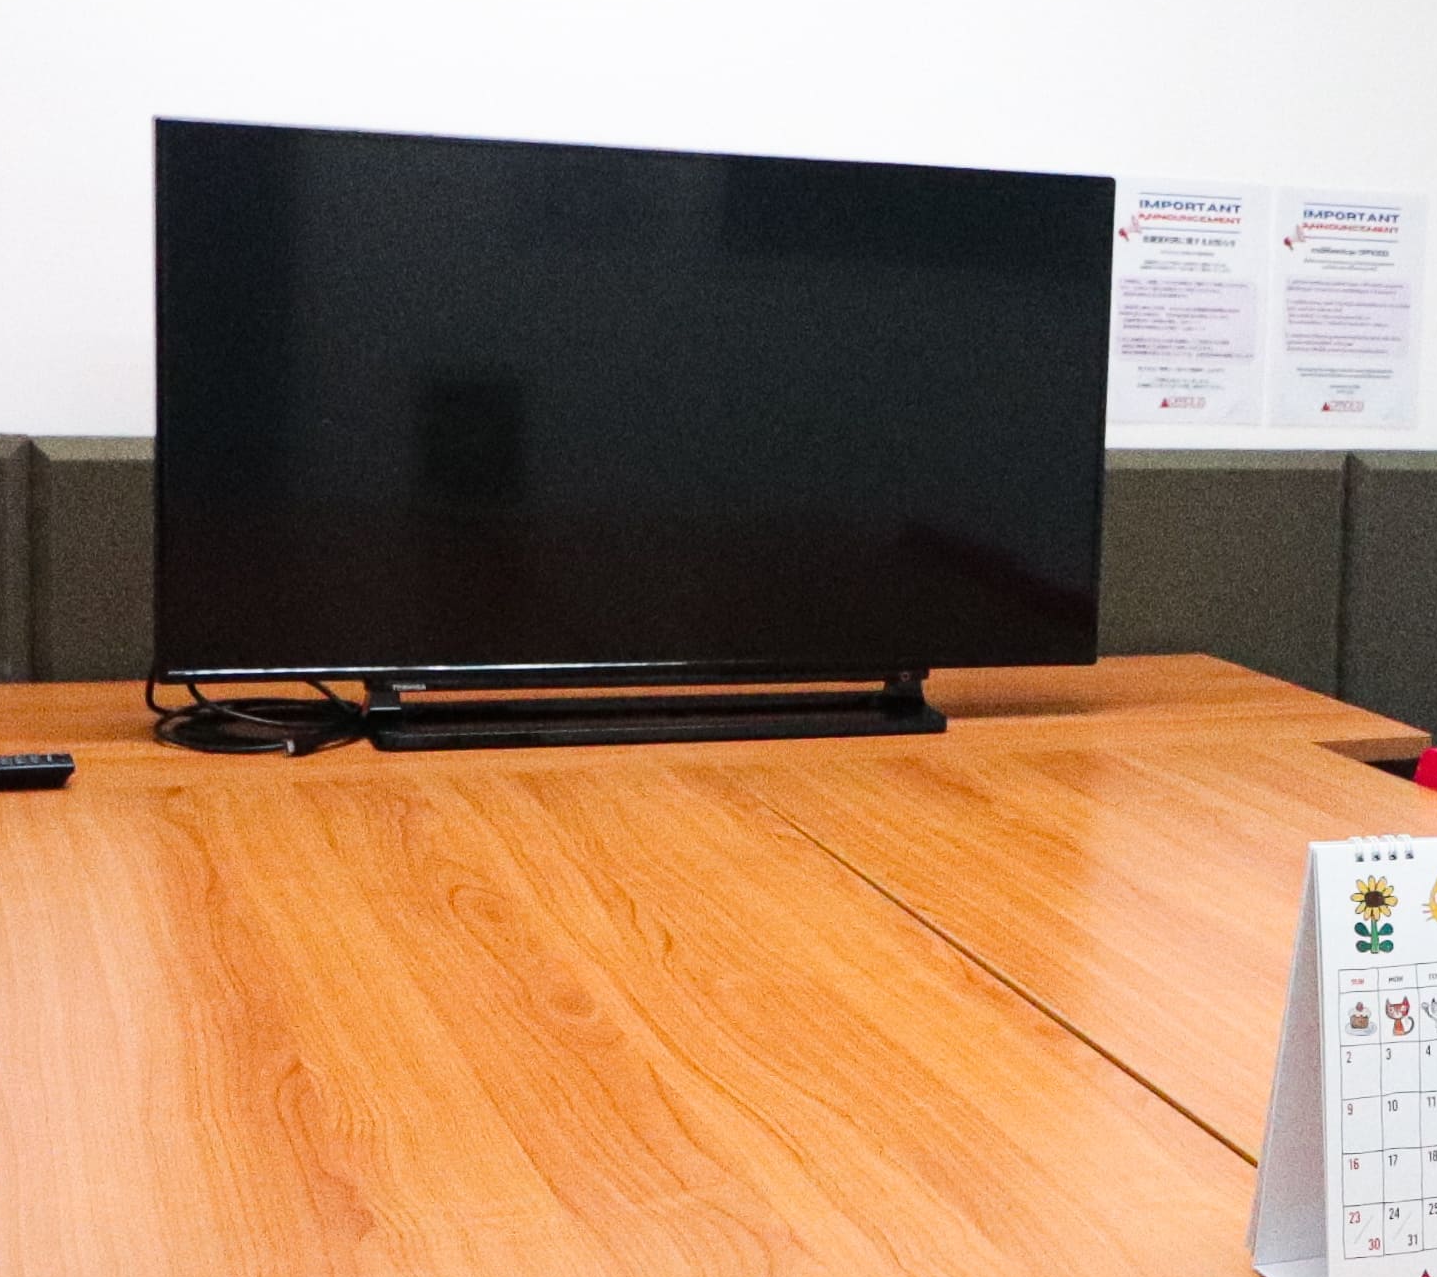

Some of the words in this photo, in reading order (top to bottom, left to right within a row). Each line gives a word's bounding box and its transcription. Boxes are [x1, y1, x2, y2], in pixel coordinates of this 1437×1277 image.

[1139, 199, 1241, 214] IMPORTANT
[1303, 209, 1399, 223] IMPORTANT
[1346, 1050, 1352, 1064] 2
[1385, 1047, 1392, 1061] 3
[1425, 1044, 1431, 1056] 4
[1346, 1103, 1354, 1116] 9
[1387, 1099, 1399, 1112] 10
[1426, 1095, 1437, 1108] 11
[1349, 1157, 1360, 1171] 16
[1387, 1153, 1399, 1167] 17
[1348, 1210, 1361, 1225] 23
[1388, 1207, 1400, 1220] 24
[1368, 1237, 1381, 1251] 30
[1407, 1233, 1418, 1247] 31
